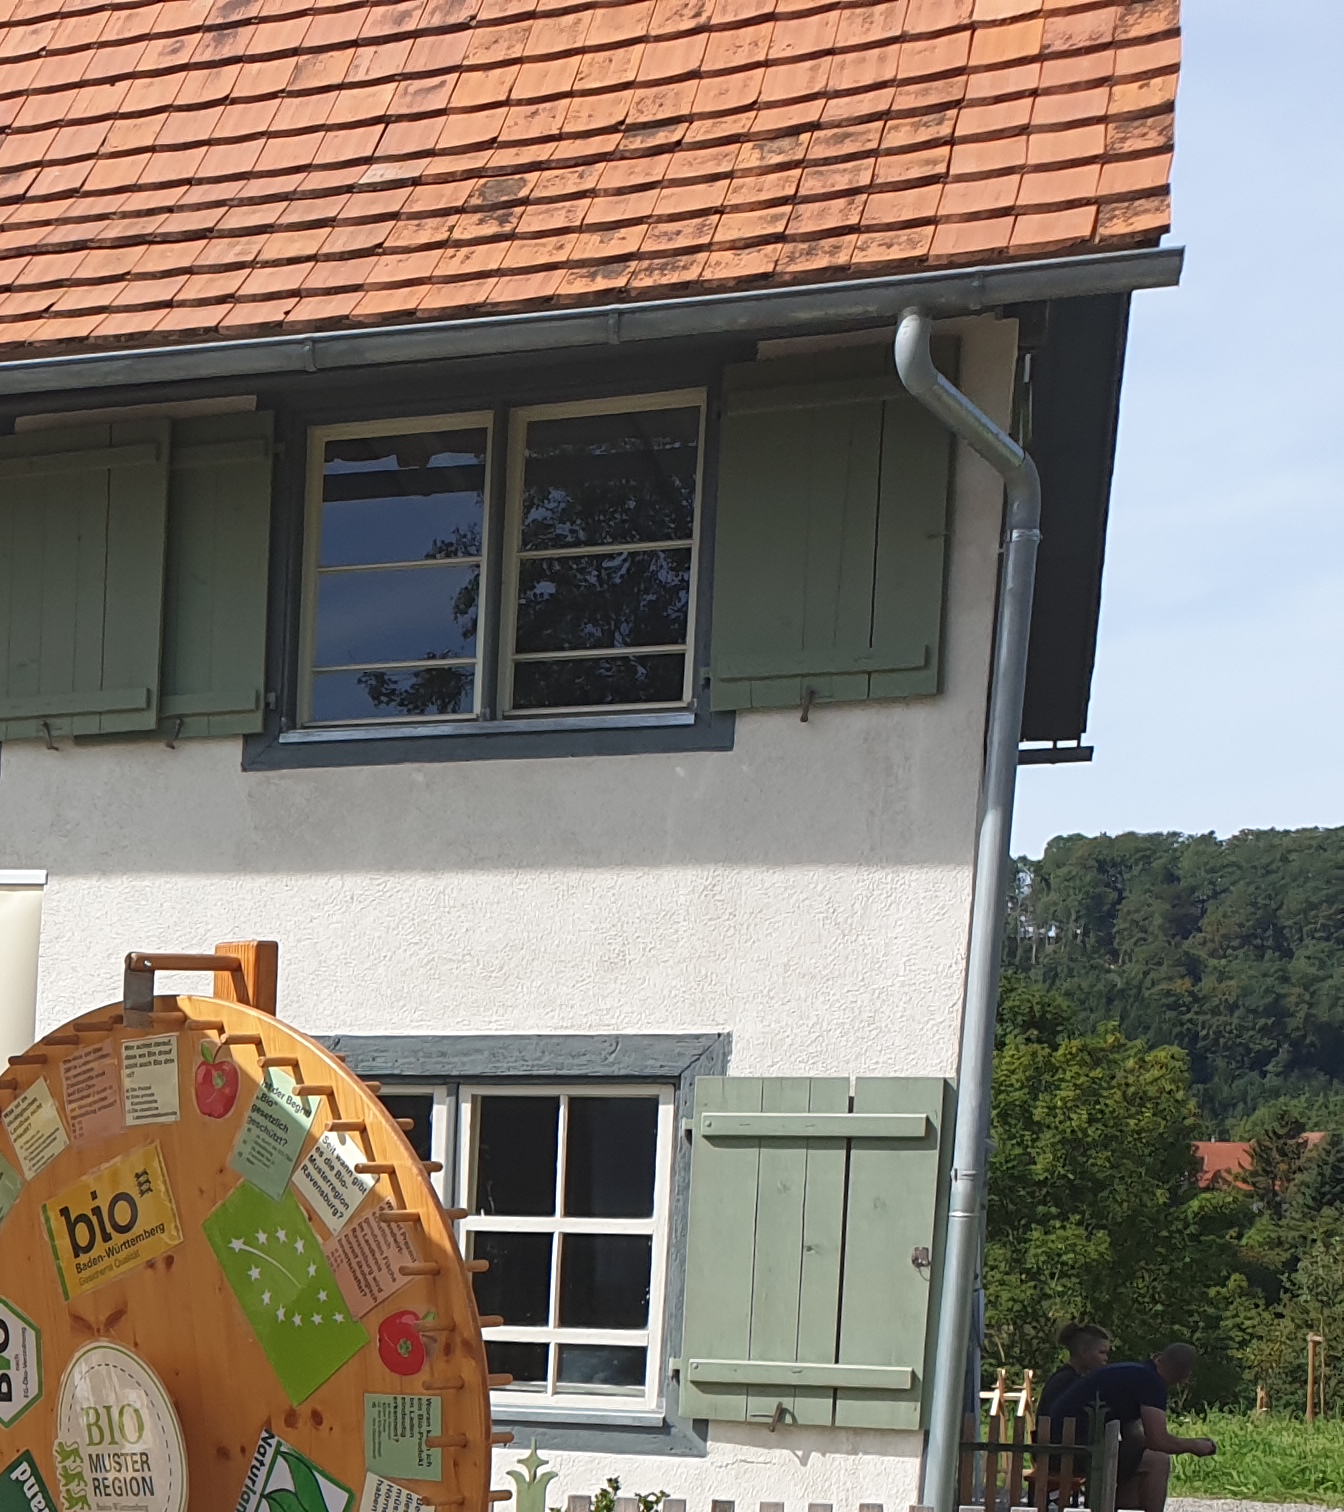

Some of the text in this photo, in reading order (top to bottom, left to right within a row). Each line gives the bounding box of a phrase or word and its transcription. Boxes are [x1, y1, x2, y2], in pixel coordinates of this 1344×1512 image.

[271, 1085, 286, 1100] der
[245, 1114, 289, 1148] geschützt?
[250, 1102, 290, 1134] gesetzlich
[306, 1153, 352, 1211] Musterregion
[313, 1145, 352, 1191] es die Bio-
[320, 1134, 369, 1196] Seit wann gibt
[298, 1162, 344, 1222] Ravensburg?
[59, 1190, 138, 1259] bio
[75, 1223, 165, 1274] Baden-Württemberg
[347, 1225, 376, 1277] Ravensburg
[360, 1231, 384, 1273] Landkreis
[81, 1402, 145, 1447] BIO
[88, 1452, 152, 1475] MUSTER
[91, 1474, 156, 1499] REGION
